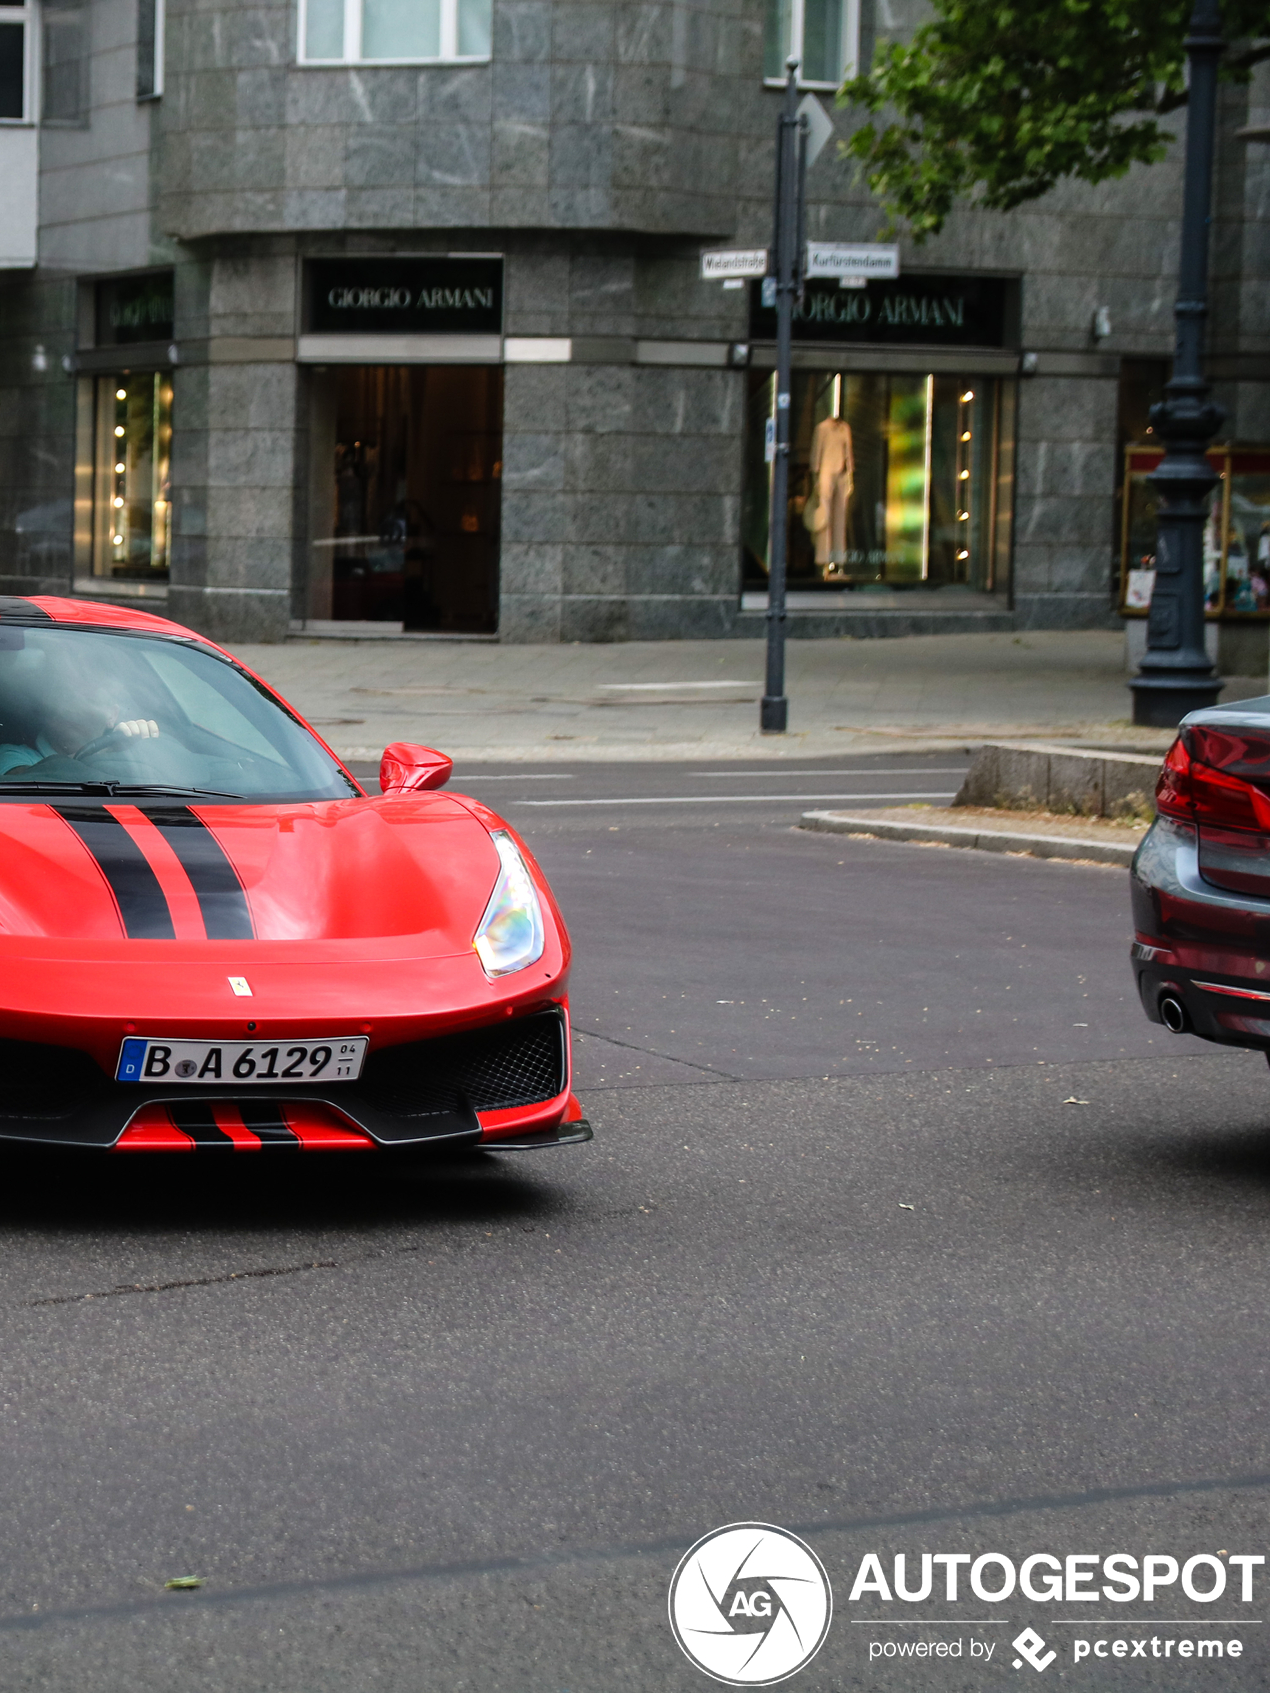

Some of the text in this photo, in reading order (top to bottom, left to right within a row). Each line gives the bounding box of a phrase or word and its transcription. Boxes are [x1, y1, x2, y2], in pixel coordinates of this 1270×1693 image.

[704, 254, 765, 270] Wielandstraße
[812, 253, 892, 269] Kurfürstendamm
[328, 286, 494, 308] GIORGIO ARMANI
[878, 294, 964, 327] ARMANI
[340, 1044, 356, 1054] 04
[125, 1045, 332, 1078] D B A 6129
[337, 1066, 351, 1076] 11
